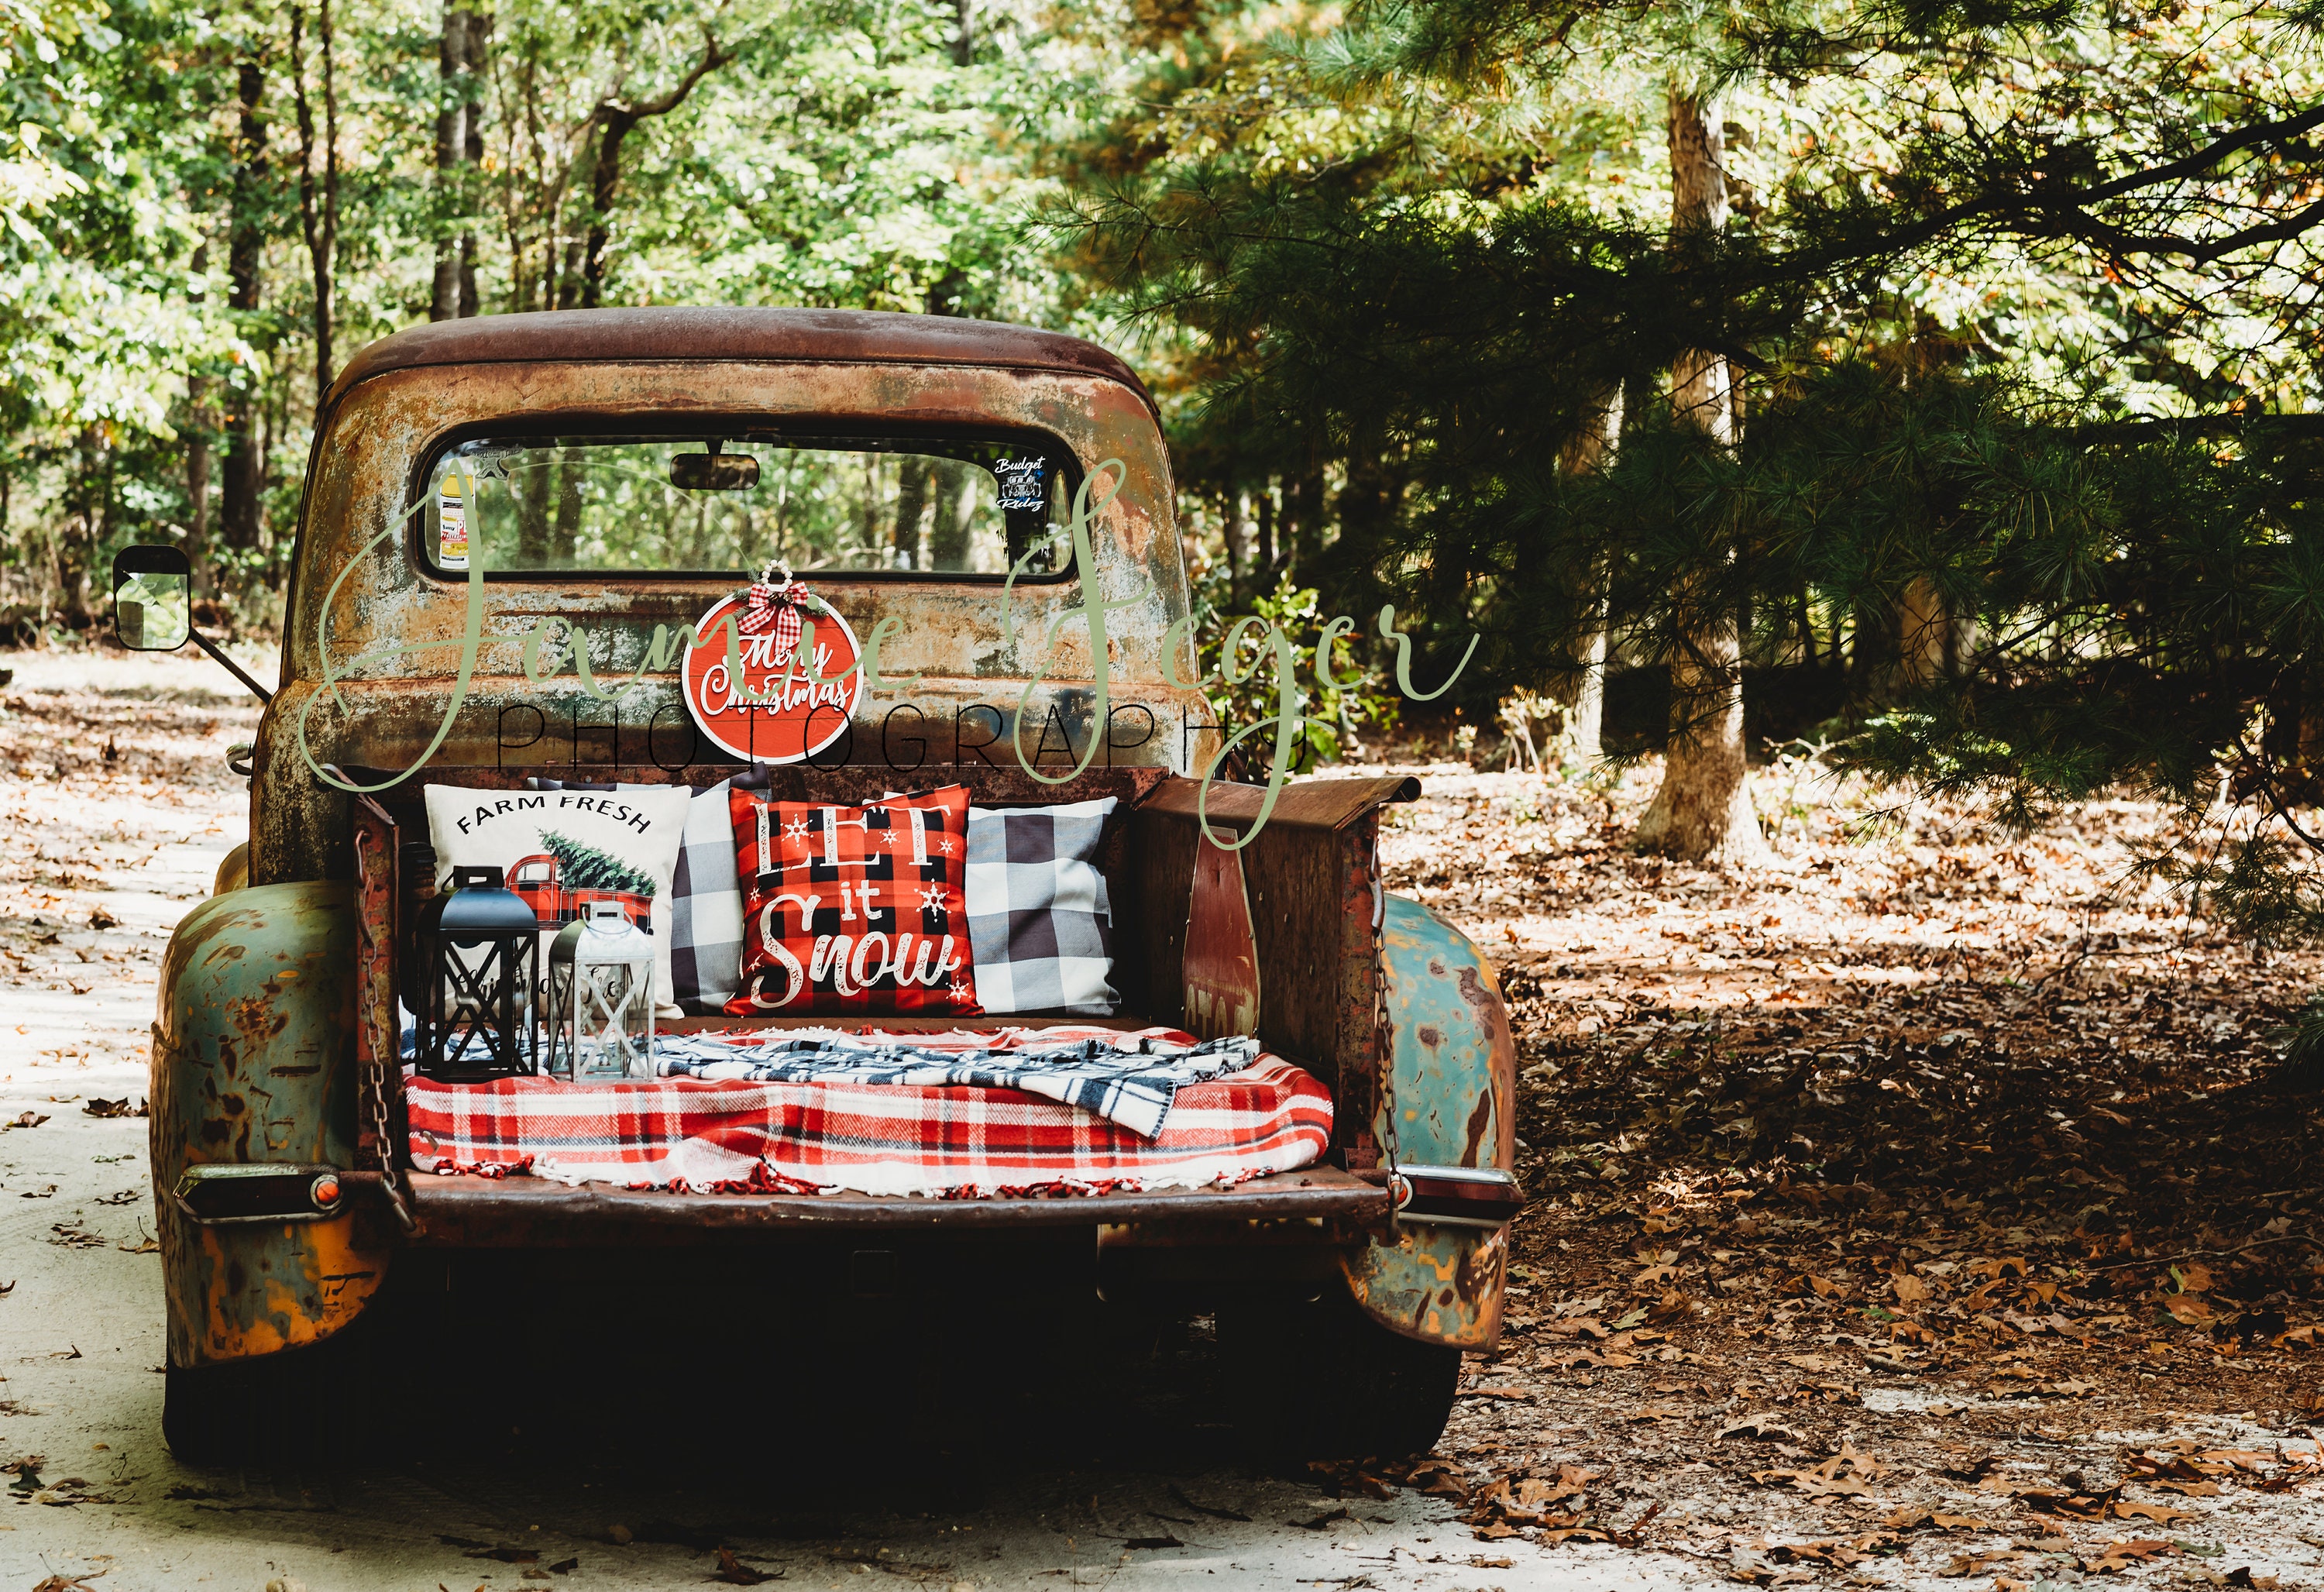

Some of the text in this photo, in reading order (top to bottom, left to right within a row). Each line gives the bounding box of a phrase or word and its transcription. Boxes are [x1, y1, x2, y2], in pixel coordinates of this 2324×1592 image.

[995, 456, 1046, 476] Budget
[456, 796, 651, 834] FARM FRESH
[750, 802, 951, 878] LET
[841, 879, 882, 921] it
[750, 894, 961, 1009] Snow
